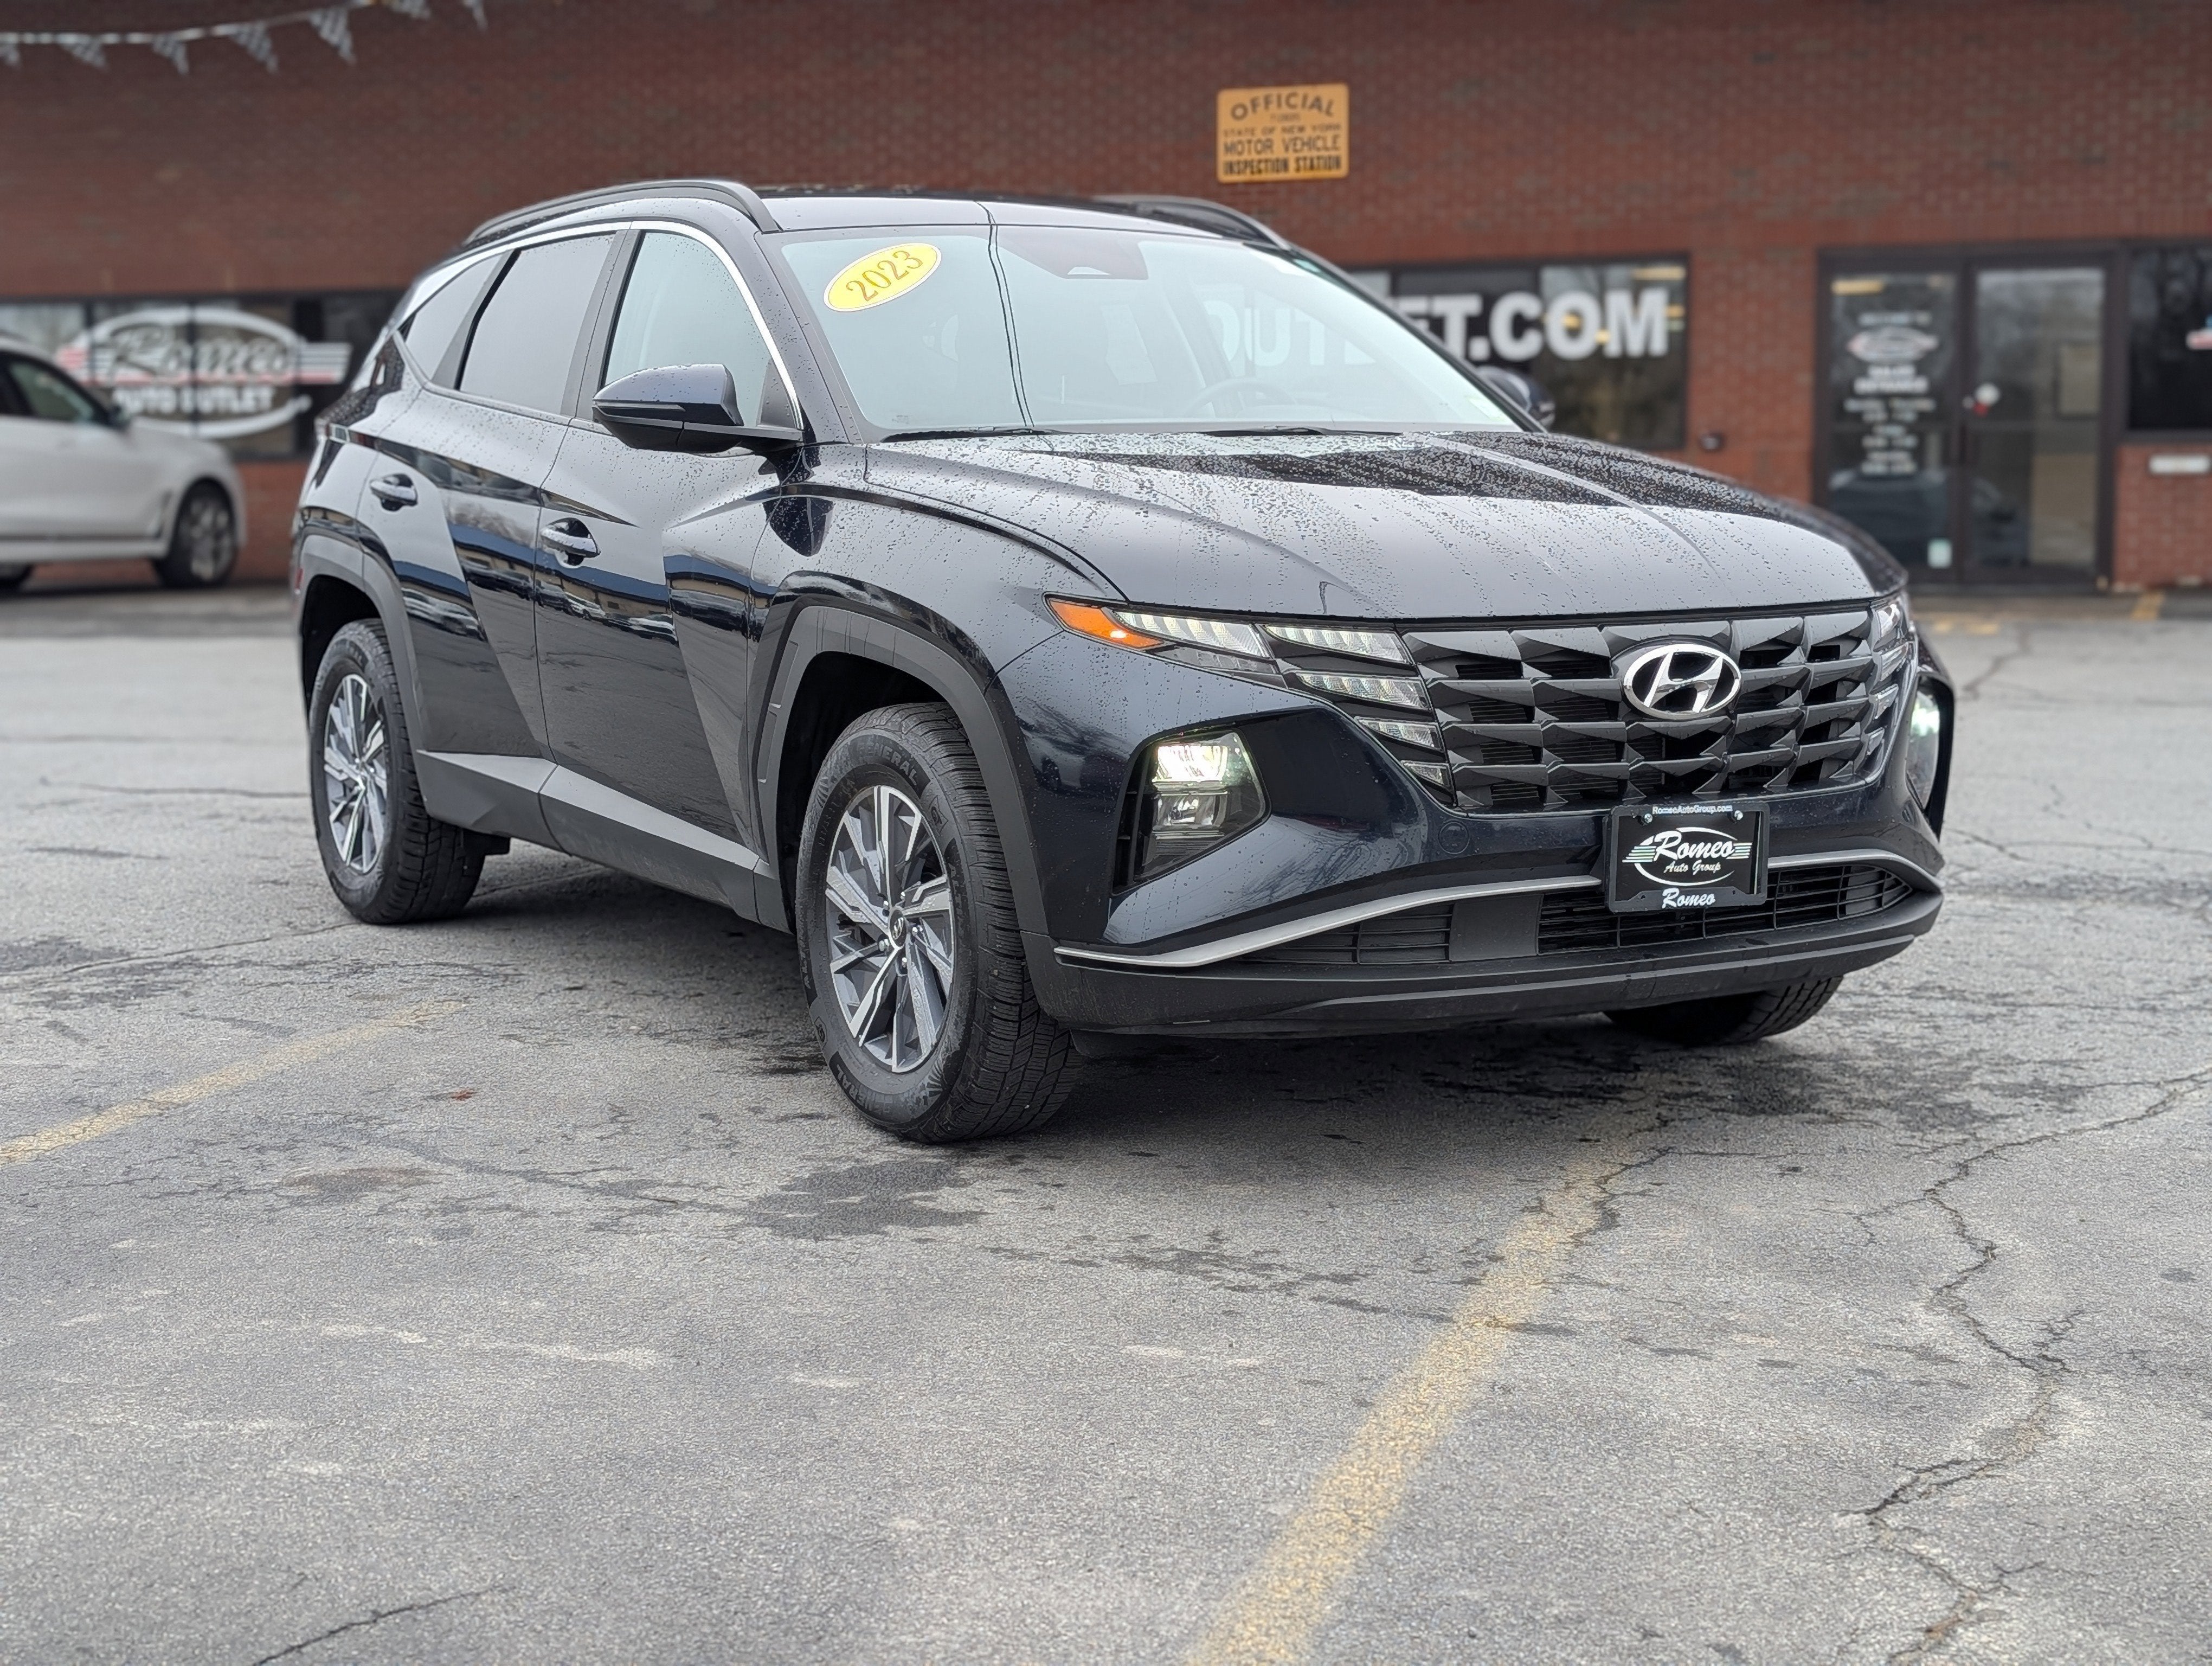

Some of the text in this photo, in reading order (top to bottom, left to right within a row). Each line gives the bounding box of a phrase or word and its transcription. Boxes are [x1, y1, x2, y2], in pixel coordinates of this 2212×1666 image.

[1230, 92, 1334, 120] OFFICIAL
[1223, 135, 1339, 155] MOTOR VEHICLE
[1223, 156, 1341, 175] INSPECTION STATION
[845, 250, 923, 302] 2023
[1652, 805, 1733, 815] RomeoAutoGroup.com
[1654, 830, 1734, 861] Romeo
[1663, 860, 1721, 876] Auto Group
[1662, 887, 1716, 909] Romeo
